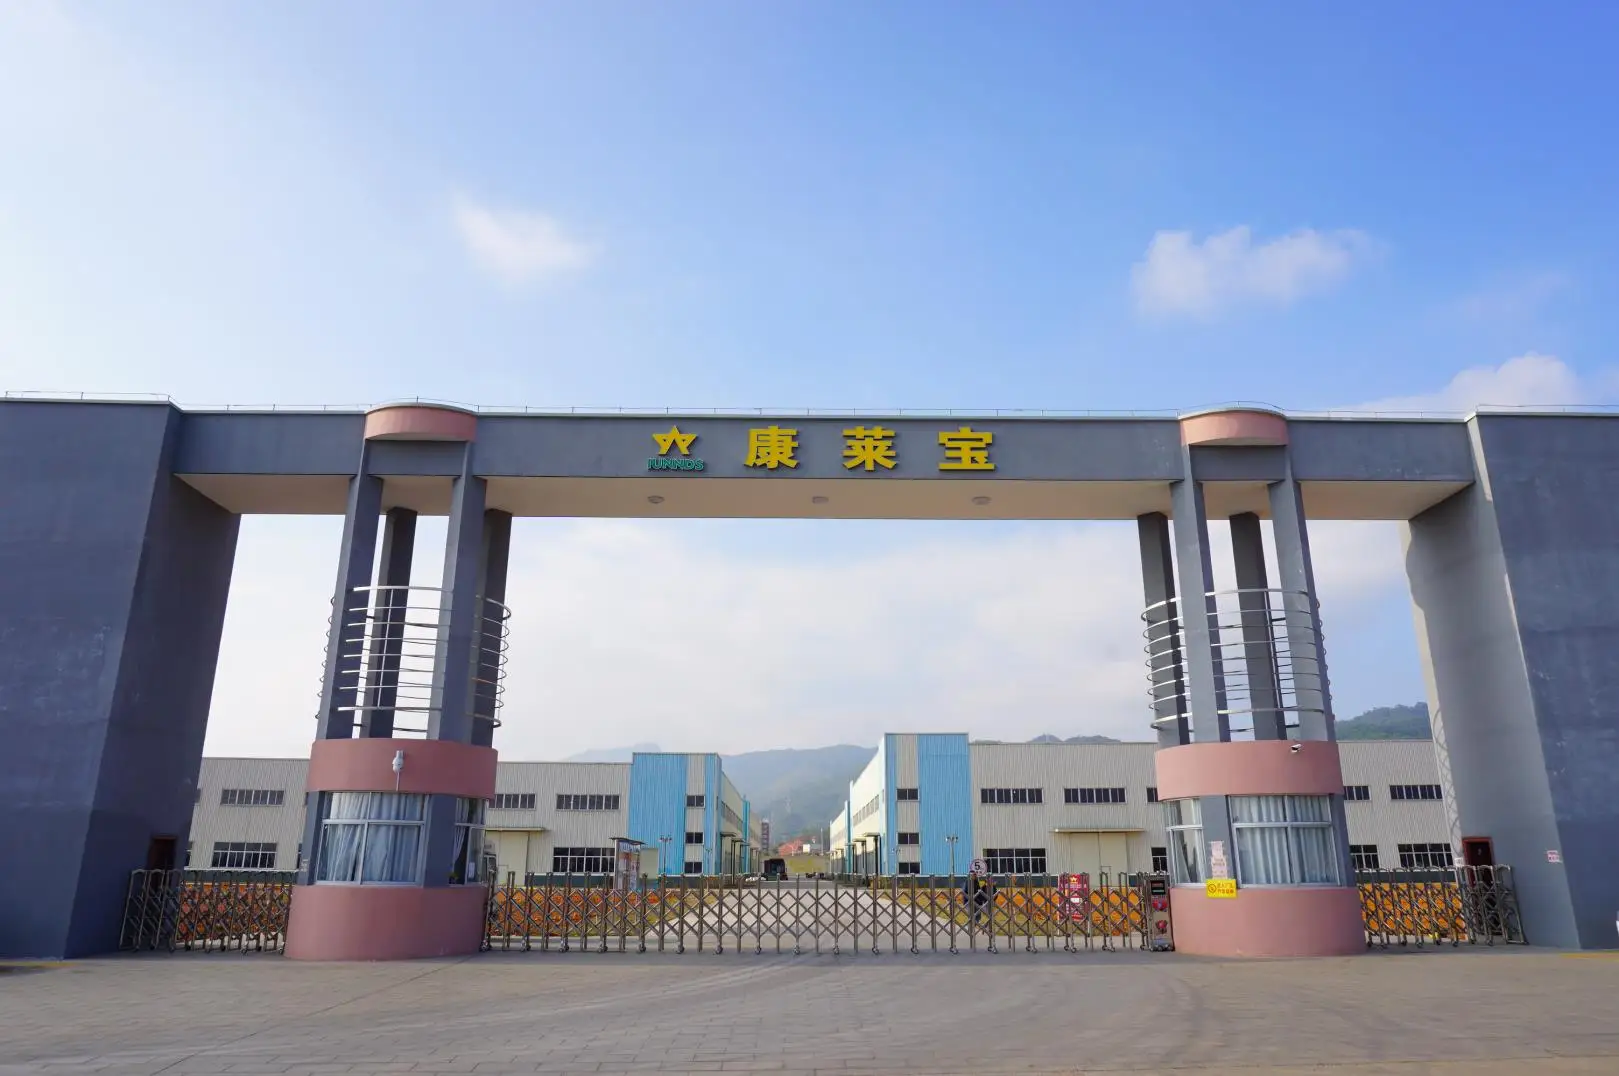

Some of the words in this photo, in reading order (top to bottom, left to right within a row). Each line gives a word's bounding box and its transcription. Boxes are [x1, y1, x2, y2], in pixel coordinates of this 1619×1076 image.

[743, 425, 995, 471] 康莱宝
[974, 861, 981, 871] 5
